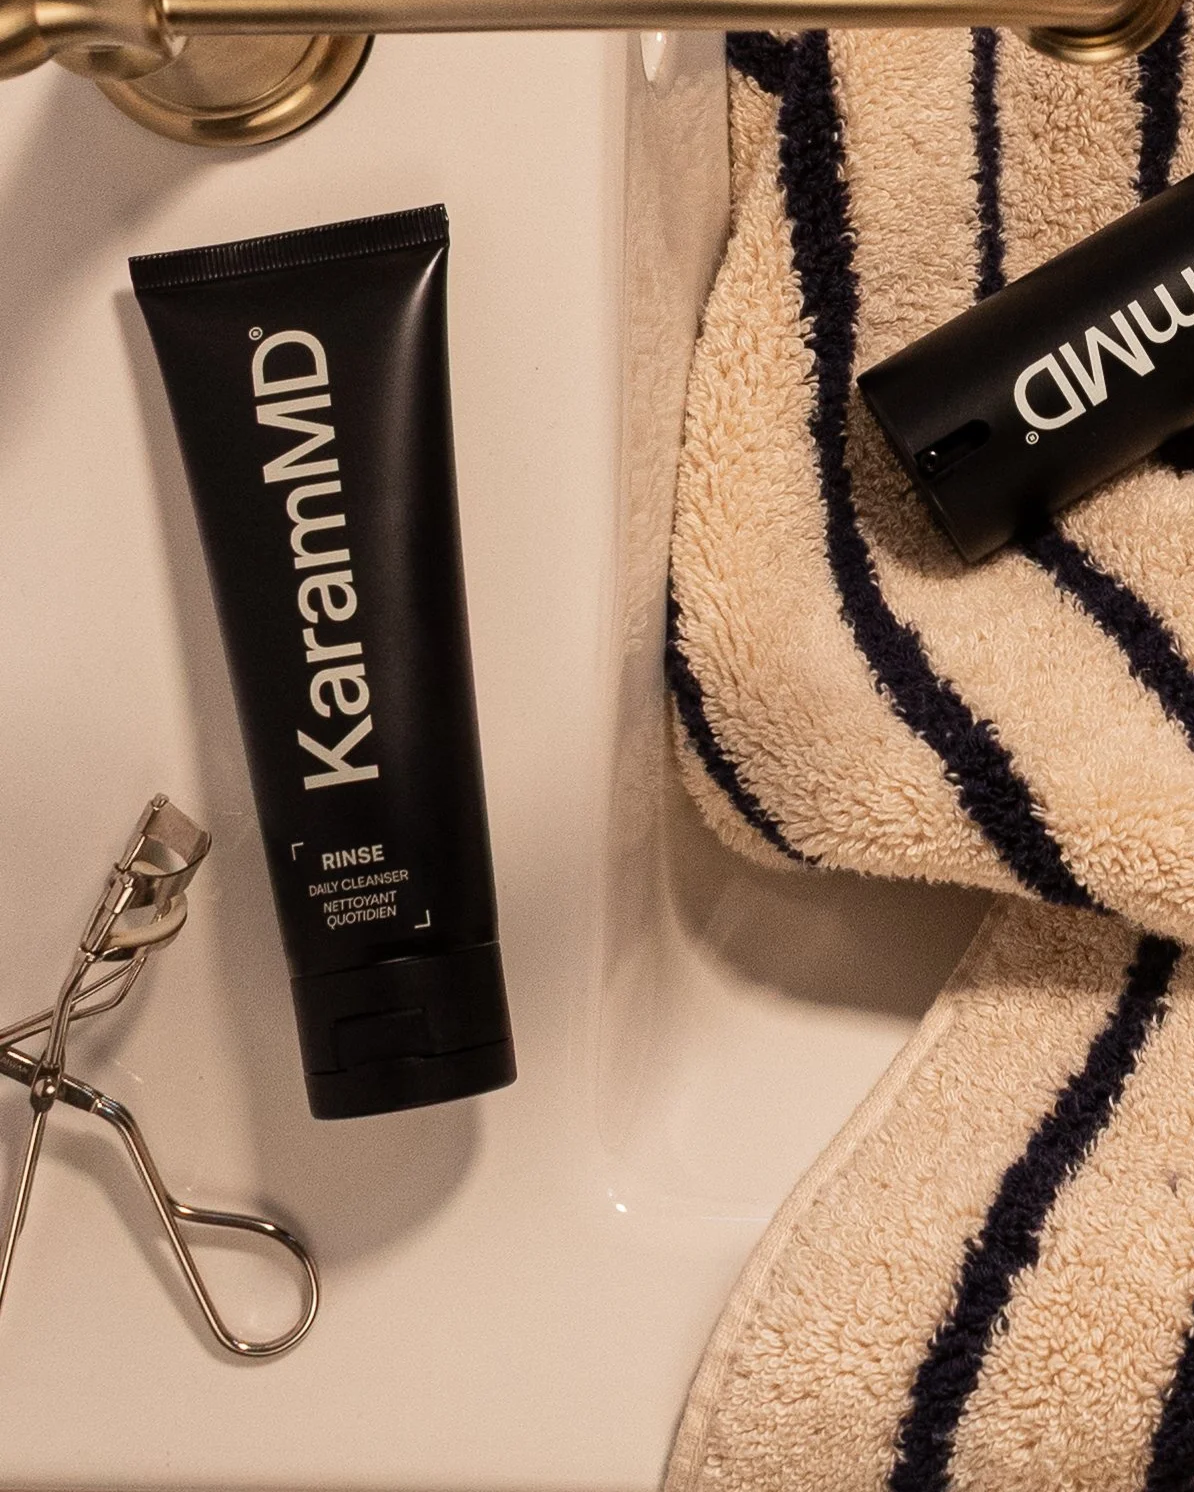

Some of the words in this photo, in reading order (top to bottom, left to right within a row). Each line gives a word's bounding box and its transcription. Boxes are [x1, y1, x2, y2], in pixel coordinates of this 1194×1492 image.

[321, 844, 385, 871] RINSE
[308, 881, 339, 897] DAILY
[341, 869, 409, 891] CLEANSER
[323, 890, 398, 914] NETTOYANT
[326, 904, 397, 931] QUOTIDIEN
